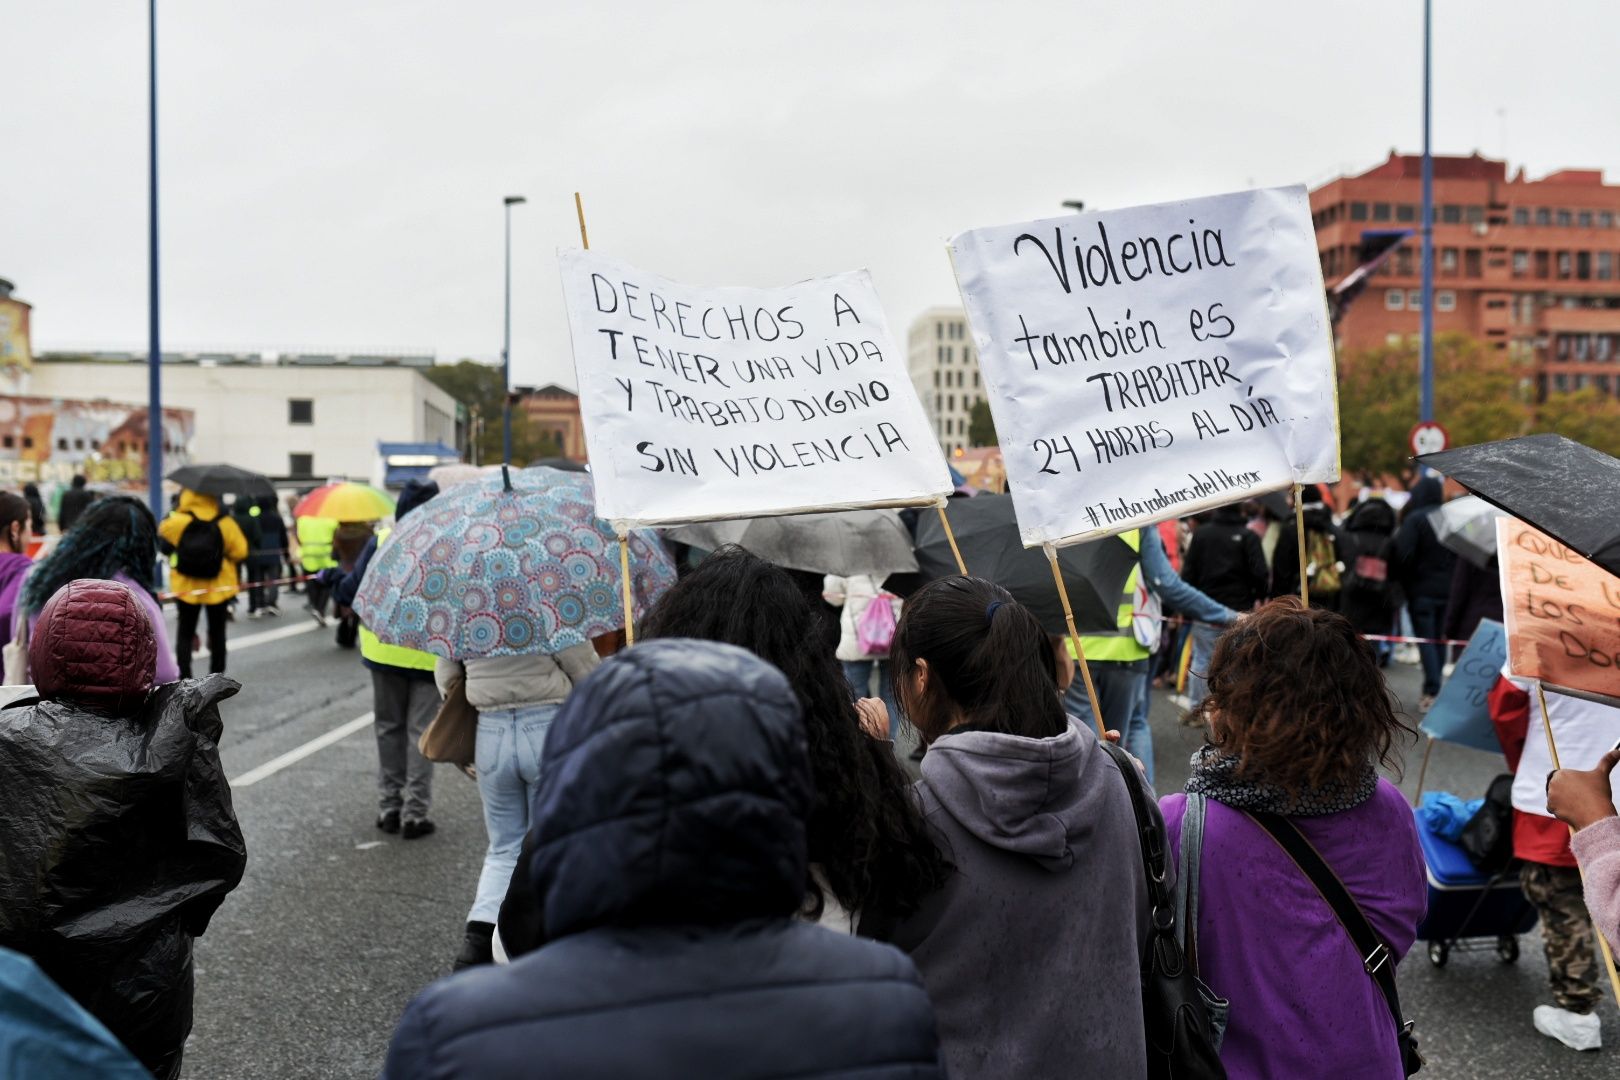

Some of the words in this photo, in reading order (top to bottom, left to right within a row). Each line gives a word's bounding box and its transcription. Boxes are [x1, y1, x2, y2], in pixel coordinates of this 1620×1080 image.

[1013, 219, 1236, 294] Violencia
[591, 273, 805, 342] DERECHOS
[832, 293, 862, 327] A
[1014, 306, 1167, 370] también
[1189, 303, 1236, 342] es
[598, 329, 730, 388] TENER
[732, 356, 795, 384] UNA
[1086, 355, 1242, 412] TRABAJAR
[615, 378, 633, 411] Y
[645, 380, 785, 427] TRABAJO
[788, 379, 890, 422] DIGNO
[636, 441, 699, 476] SIN
[714, 422, 910, 477] VIOLENCIA
[1033, 434, 1082, 475] 24
[1085, 421, 1175, 465] HORAS
[1191, 408, 1230, 441] AL
